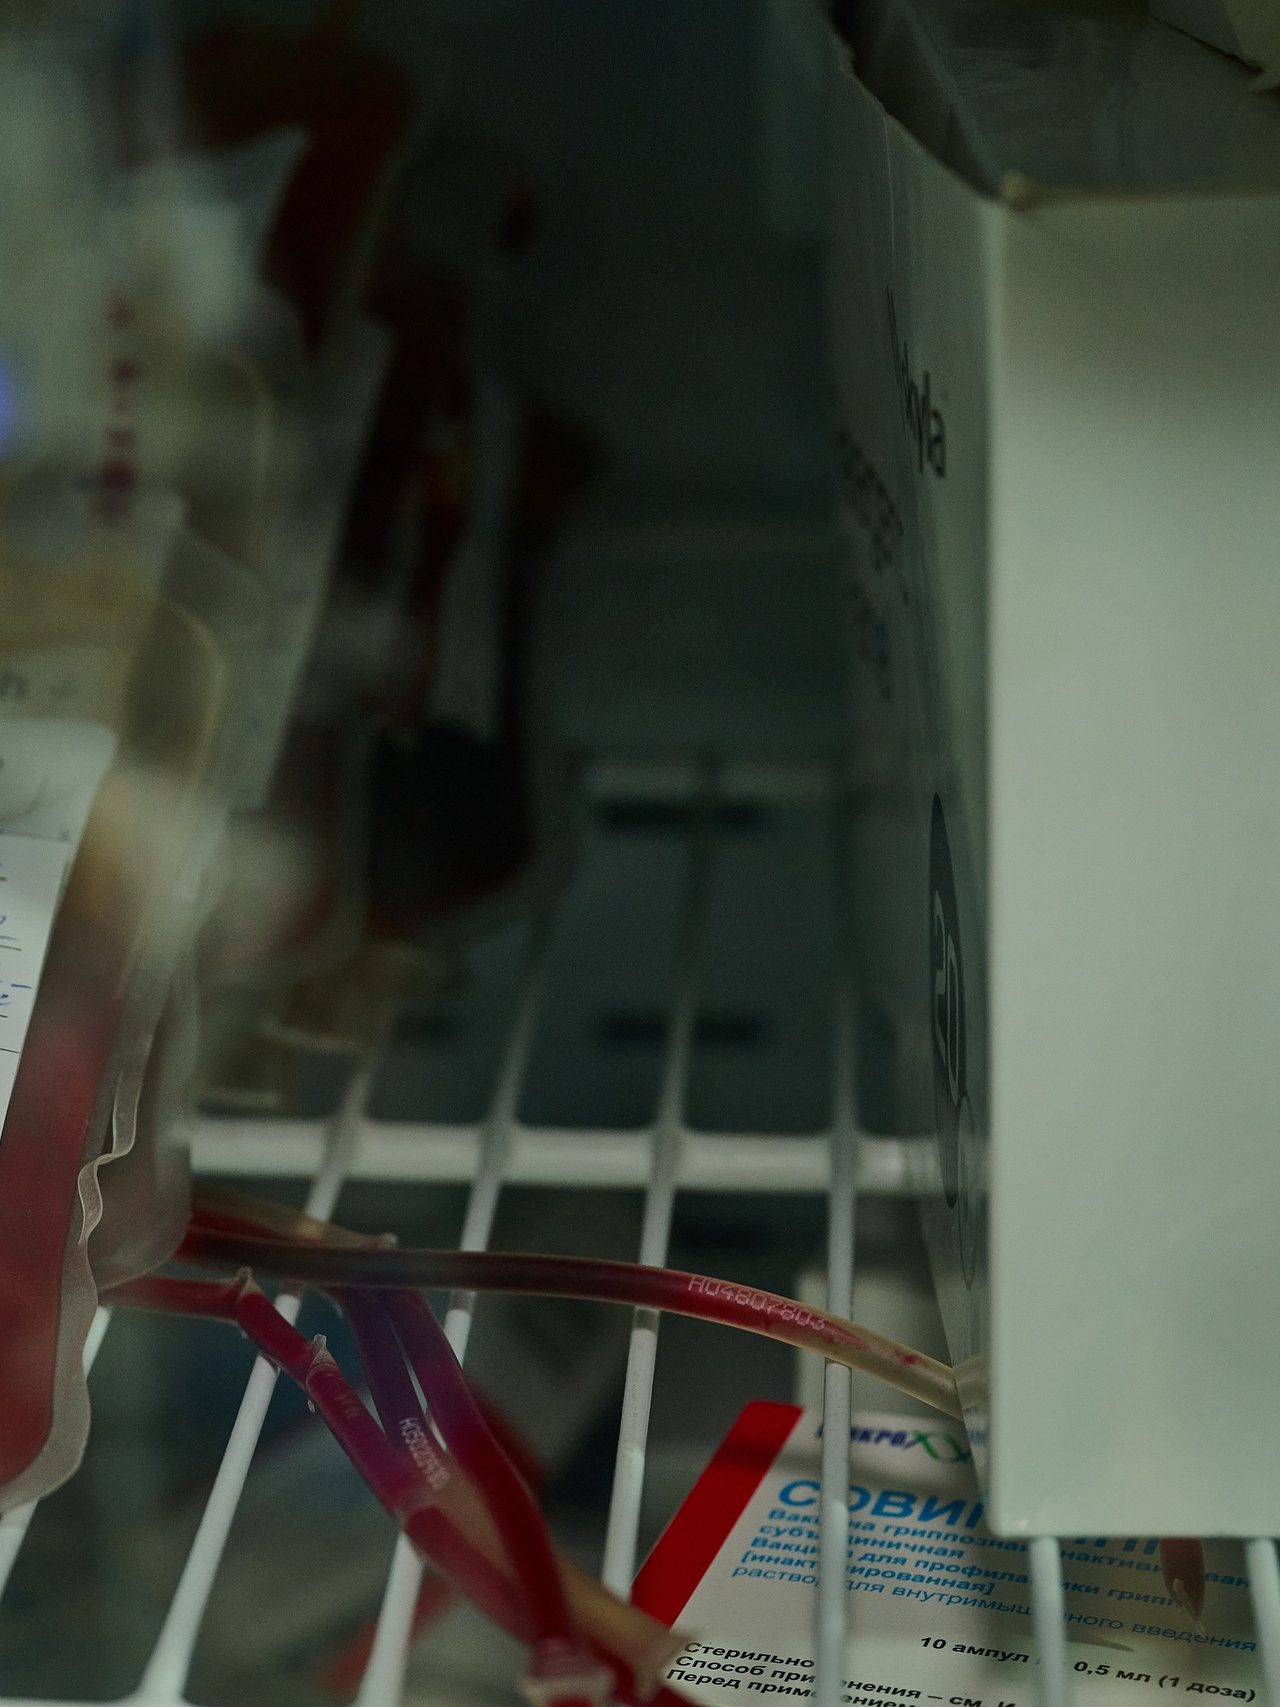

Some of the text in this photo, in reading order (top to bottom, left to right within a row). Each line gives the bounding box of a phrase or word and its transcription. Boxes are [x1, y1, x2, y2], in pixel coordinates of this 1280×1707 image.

[768, 1507, 877, 1532] Вакна
[758, 1524, 965, 1560] субъиничная
[741, 1550, 996, 1596] [инактированная]
[858, 1551, 907, 1566] для
[914, 1558, 1100, 1596] профилаики
[732, 1566, 819, 1588] раство
[892, 1586, 1124, 1630] внутримышного
[1131, 1623, 1258, 1652] введения
[684, 1641, 816, 1669] Стерильно
[920, 1636, 947, 1650] 10
[952, 1642, 1030, 1664] ампул
[666, 1668, 742, 1690] Перед
[675, 1655, 767, 1677] Способ
[770, 1669, 922, 1700] принения
[1073, 1660, 1111, 1676] 0,5
[1116, 1669, 1151, 1683] мл
[1158, 1674, 1180, 1689] (1
[1186, 1682, 1257, 1704] доза)
